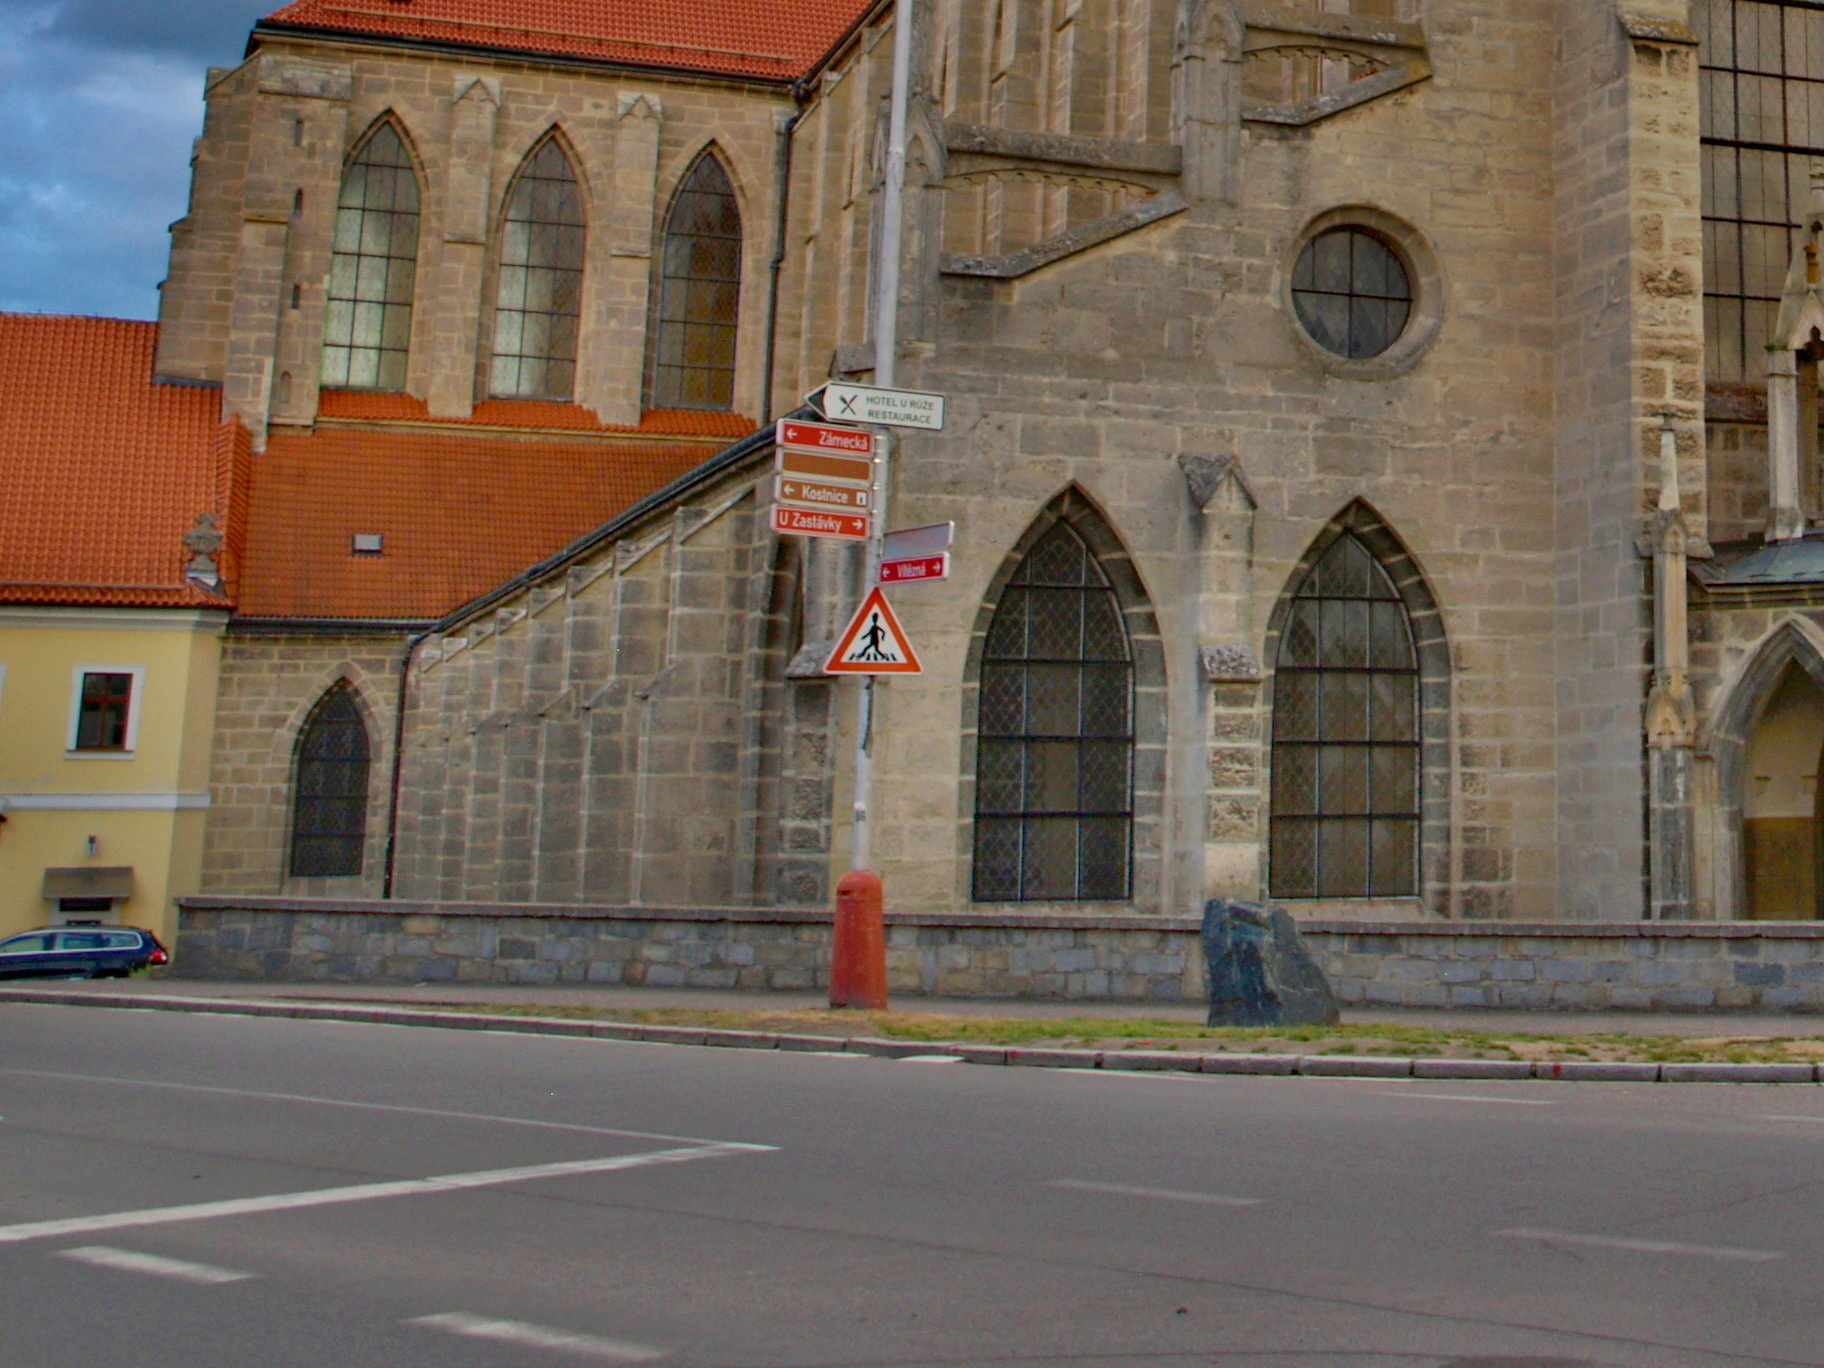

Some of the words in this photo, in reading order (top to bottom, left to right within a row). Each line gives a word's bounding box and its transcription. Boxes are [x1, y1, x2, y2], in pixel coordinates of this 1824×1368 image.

[866, 395, 897, 407] HOTEL
[900, 399, 907, 408] U
[868, 409, 932, 424] RESTAURACE
[819, 431, 868, 450] Zámecká
[802, 485, 848, 504] Kostnice
[779, 511, 788, 525] U
[792, 512, 842, 533] Zastávky
